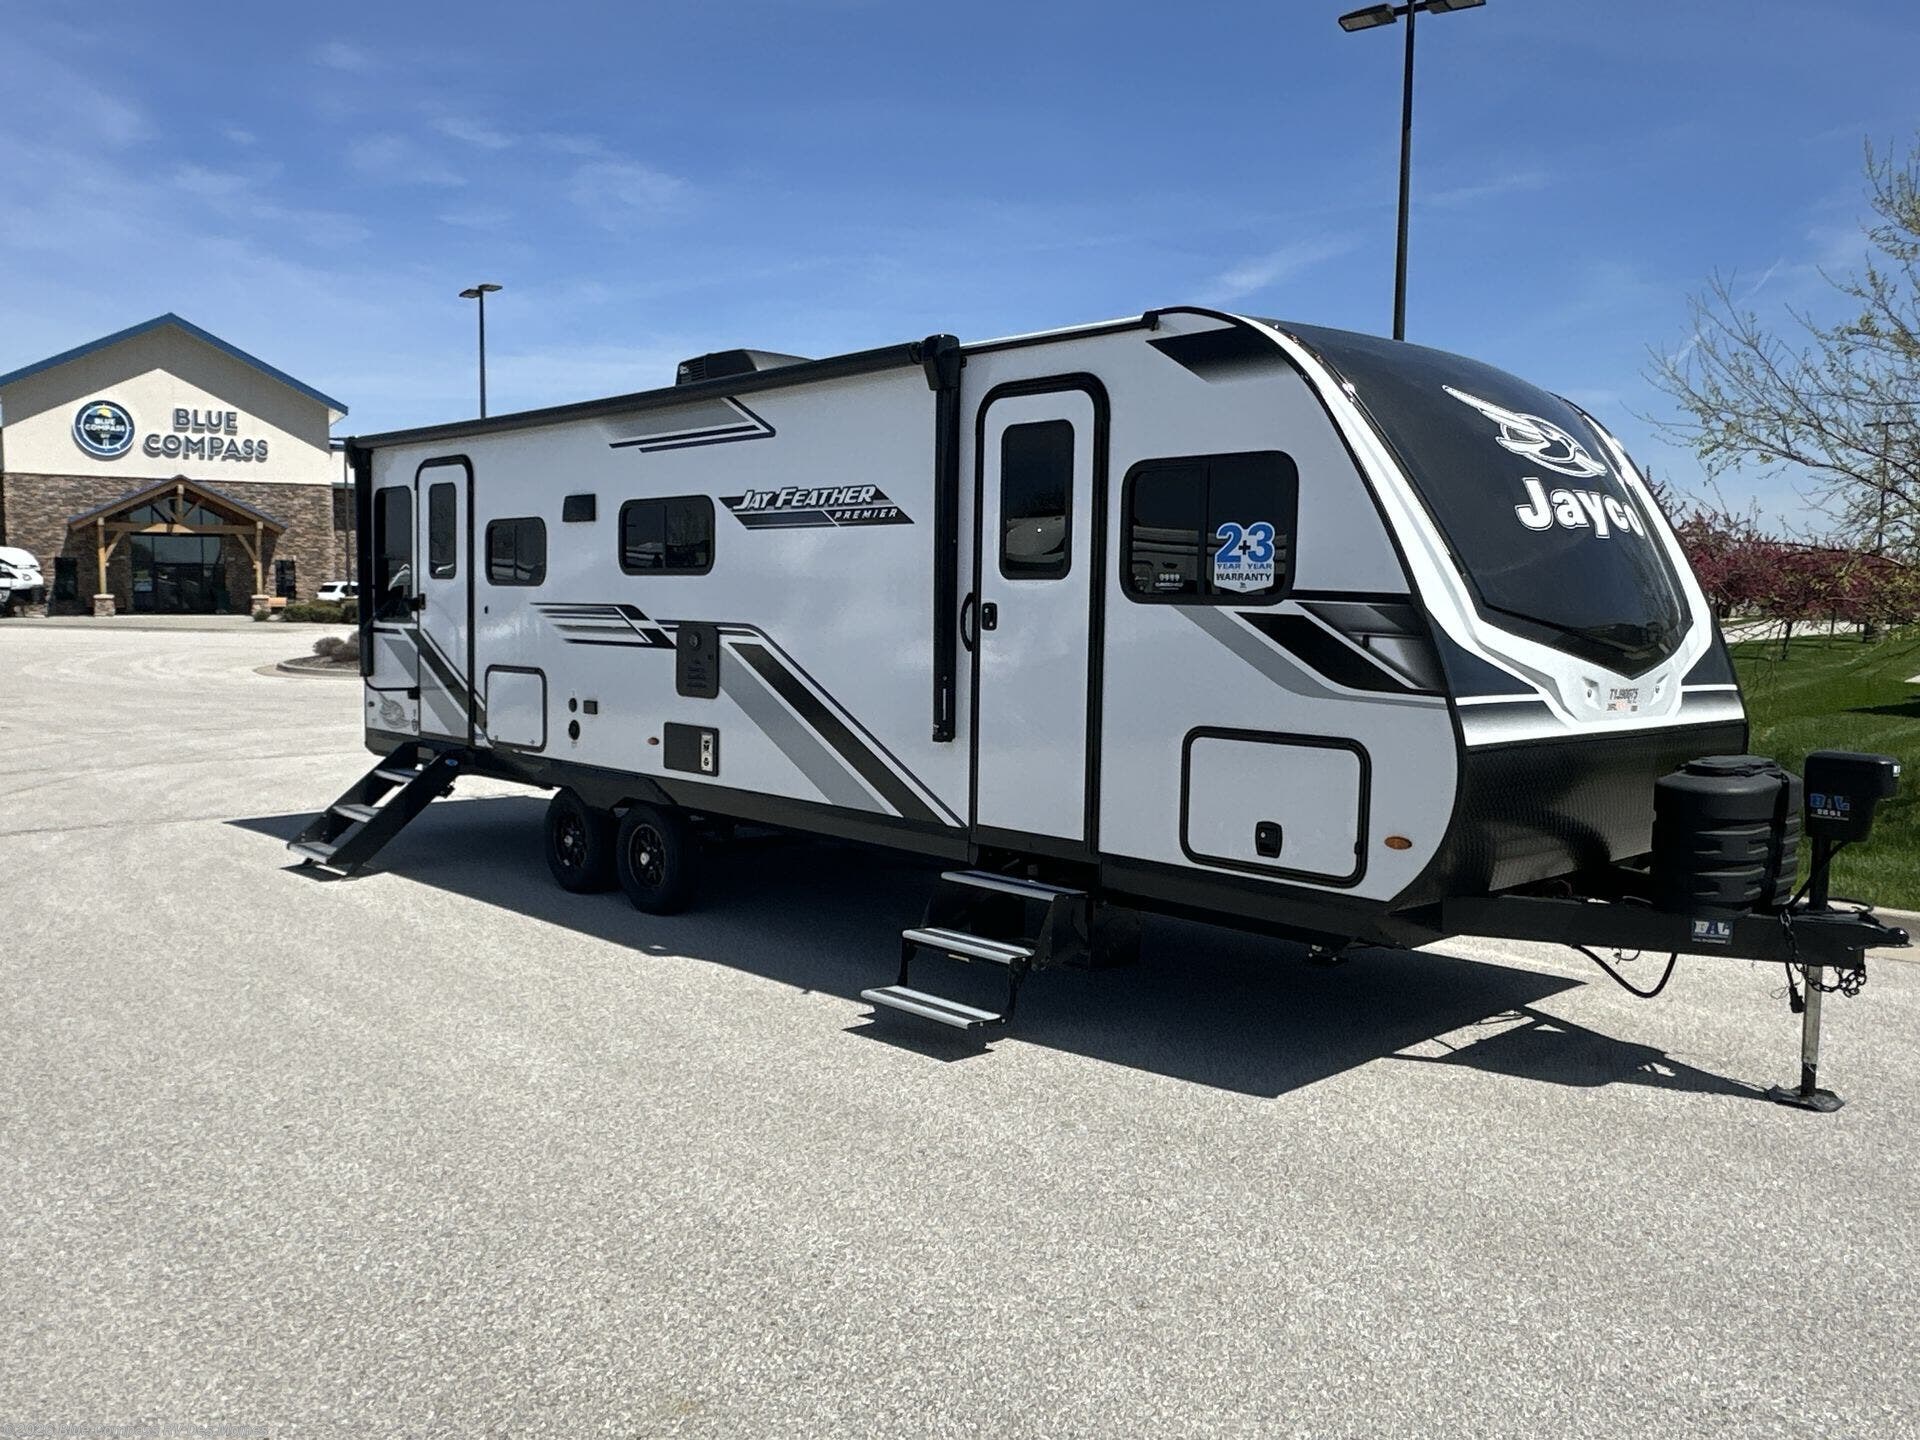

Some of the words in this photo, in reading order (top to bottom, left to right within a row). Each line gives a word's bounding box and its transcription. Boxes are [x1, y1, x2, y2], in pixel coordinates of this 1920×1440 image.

[173, 407, 238, 430] BLUE
[144, 433, 269, 459] COMPASS
[732, 489, 773, 511] JAY
[774, 485, 877, 509] FEATHER
[1515, 477, 1645, 539] Jayco
[834, 508, 898, 520] PREMIER
[1216, 572, 1272, 582] WARRANTY
[1217, 562, 1241, 570] YEAR
[1248, 562, 1273, 570] YEAR
